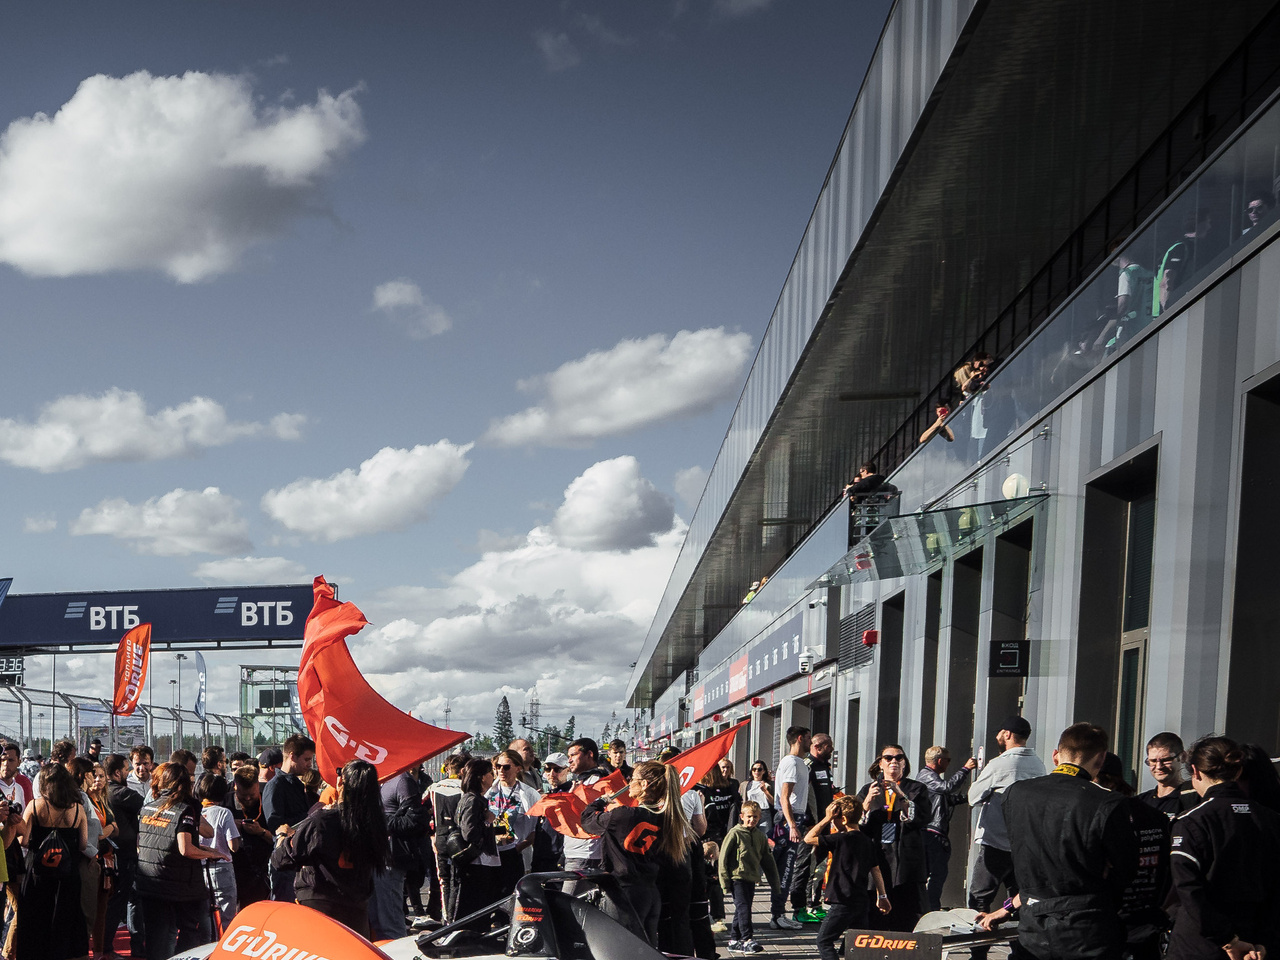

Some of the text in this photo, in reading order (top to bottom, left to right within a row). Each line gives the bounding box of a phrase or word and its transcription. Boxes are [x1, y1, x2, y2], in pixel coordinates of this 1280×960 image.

[89, 605, 140, 630] ВТБ
[241, 601, 294, 626] ВТБ
[123, 638, 132, 682] ТОПЛИВО
[624, 821, 662, 855] G
[42, 848, 63, 868] G
